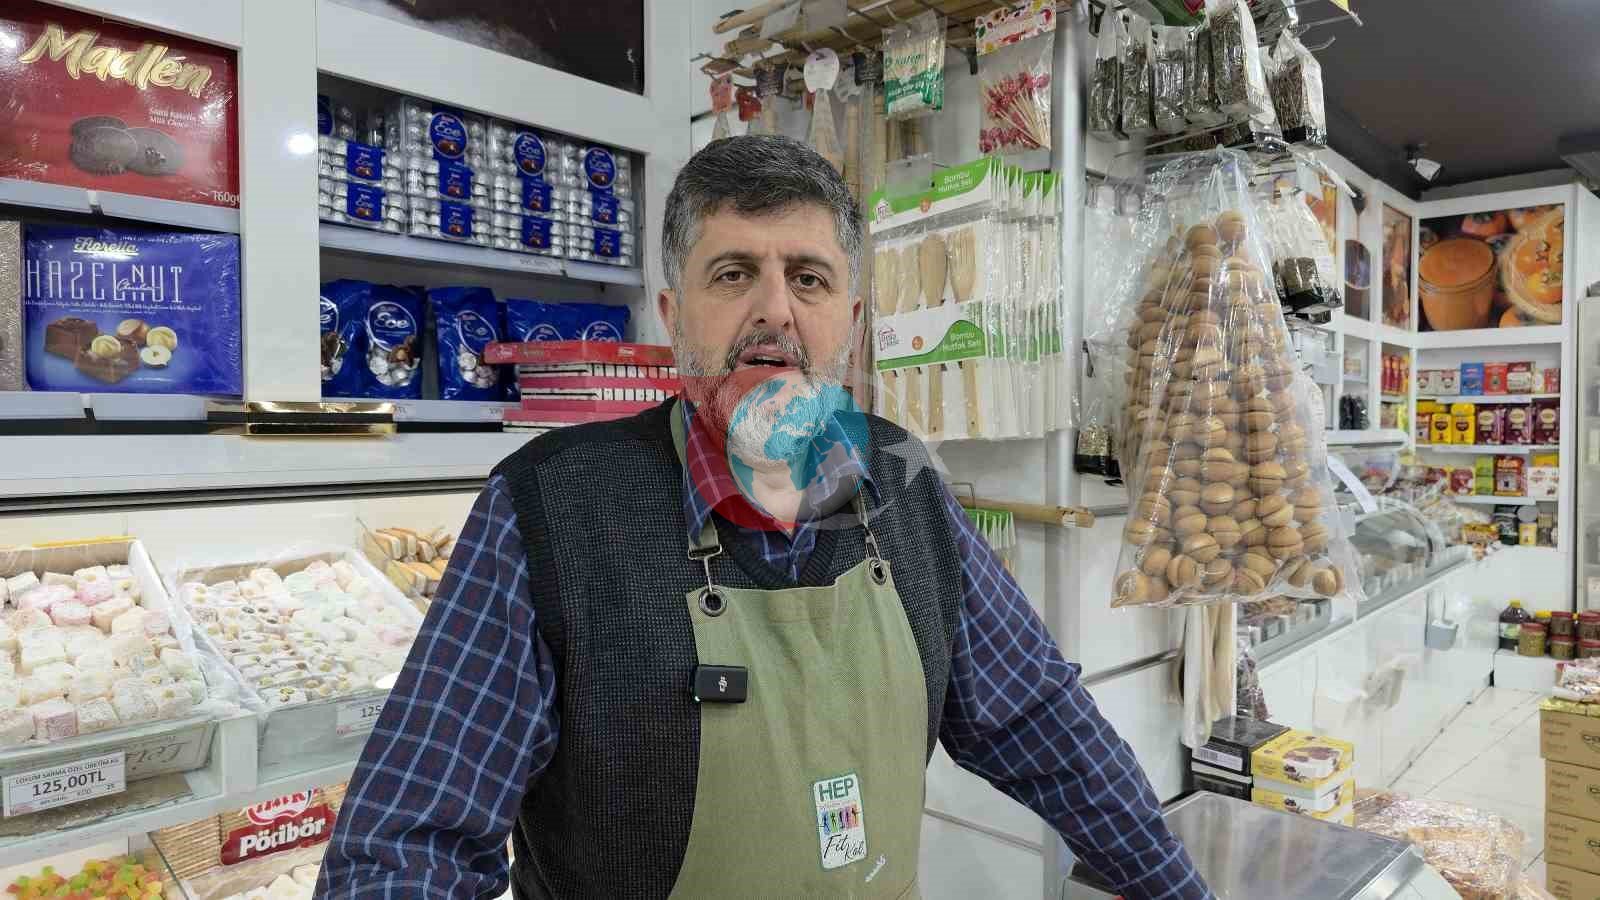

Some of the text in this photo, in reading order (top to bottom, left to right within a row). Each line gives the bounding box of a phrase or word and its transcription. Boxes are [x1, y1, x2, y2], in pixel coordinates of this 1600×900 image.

[32, 770, 107, 797] 125,00TL
[818, 778, 854, 802] HEP
[239, 816, 326, 858] Pötibör
[824, 833, 848, 859] Fit
